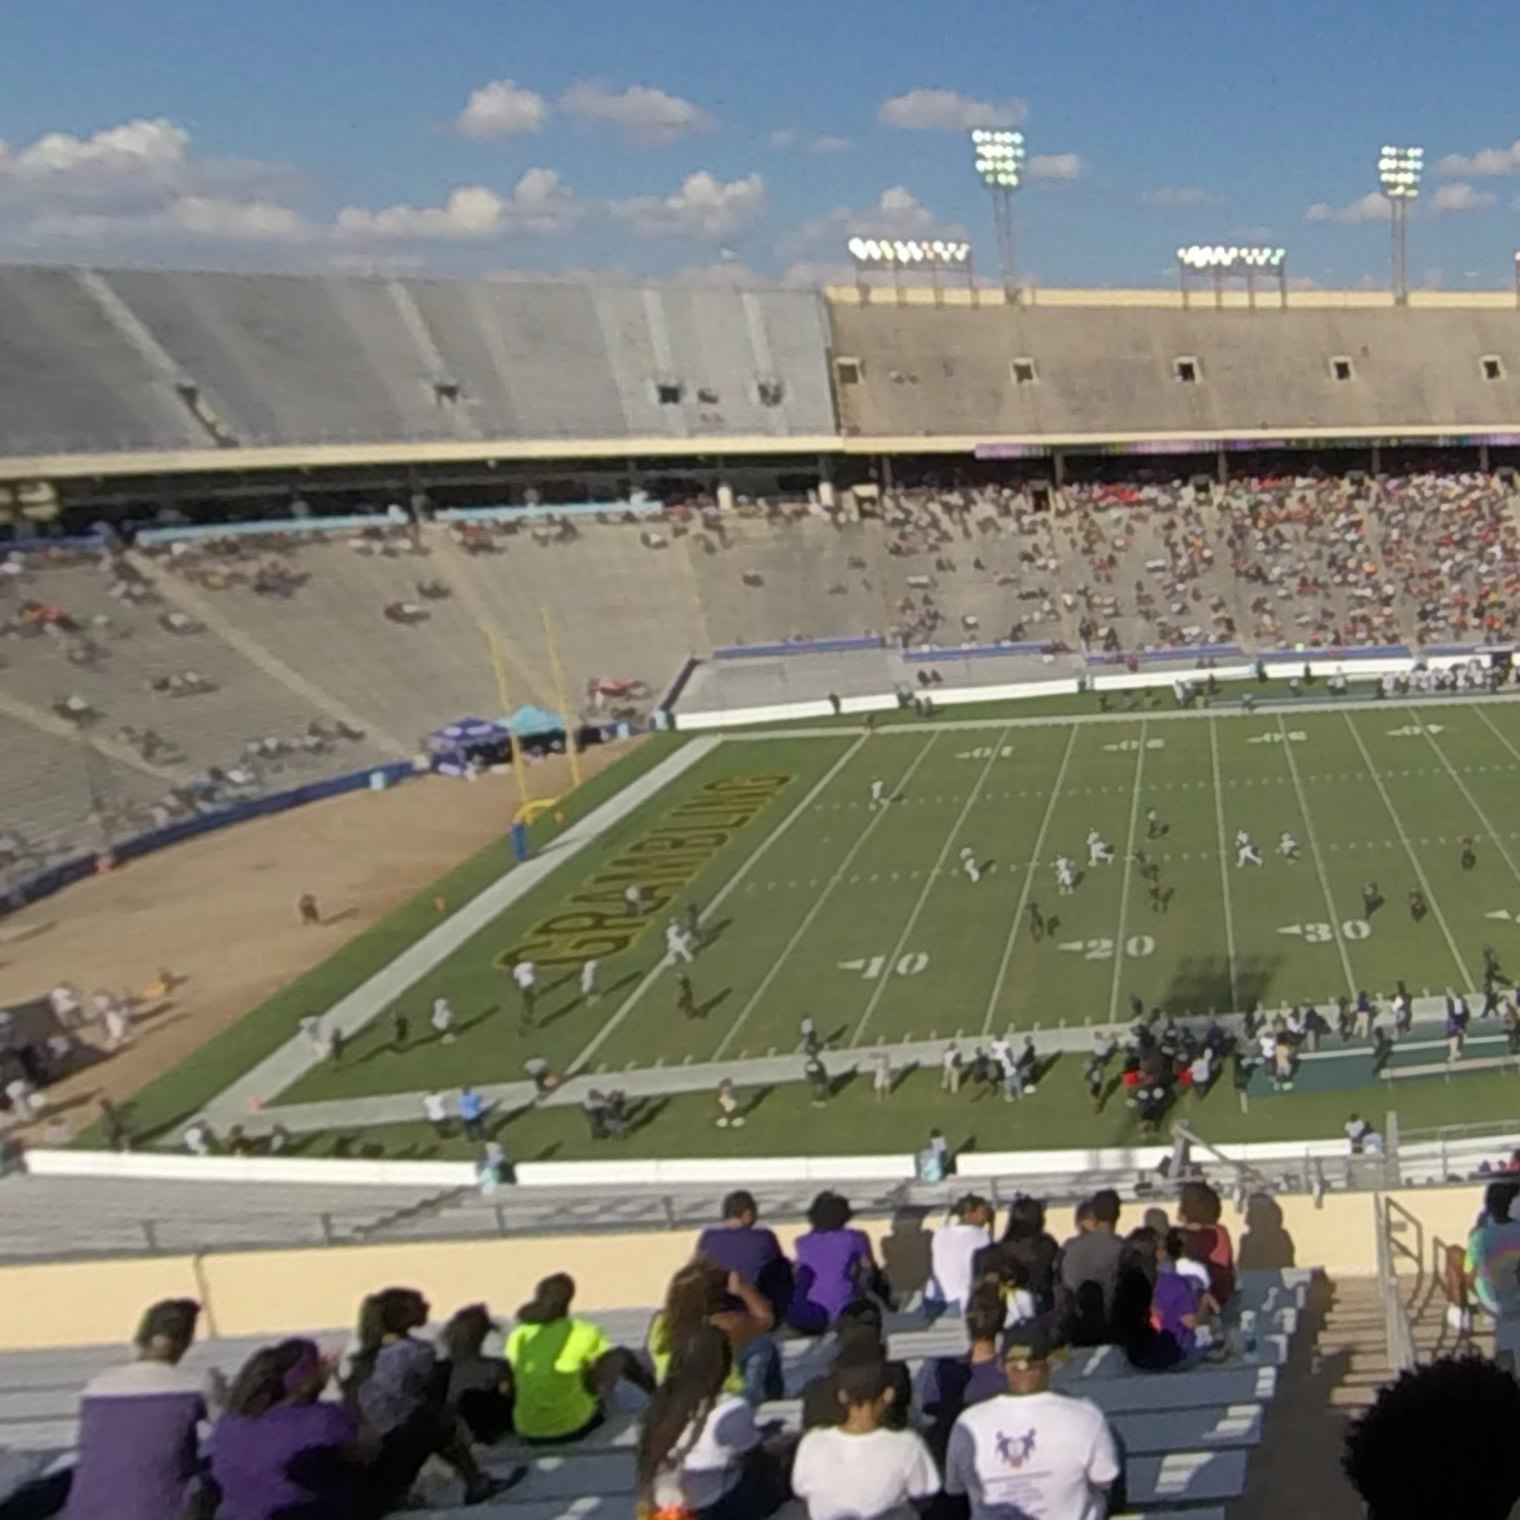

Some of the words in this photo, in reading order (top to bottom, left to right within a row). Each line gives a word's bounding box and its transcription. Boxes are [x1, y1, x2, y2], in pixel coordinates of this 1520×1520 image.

[492, 774, 793, 967] GRAMBLING
[1304, 919, 1372, 943] 30
[1085, 934, 1156, 960] 20
[861, 952, 929, 979] 10
